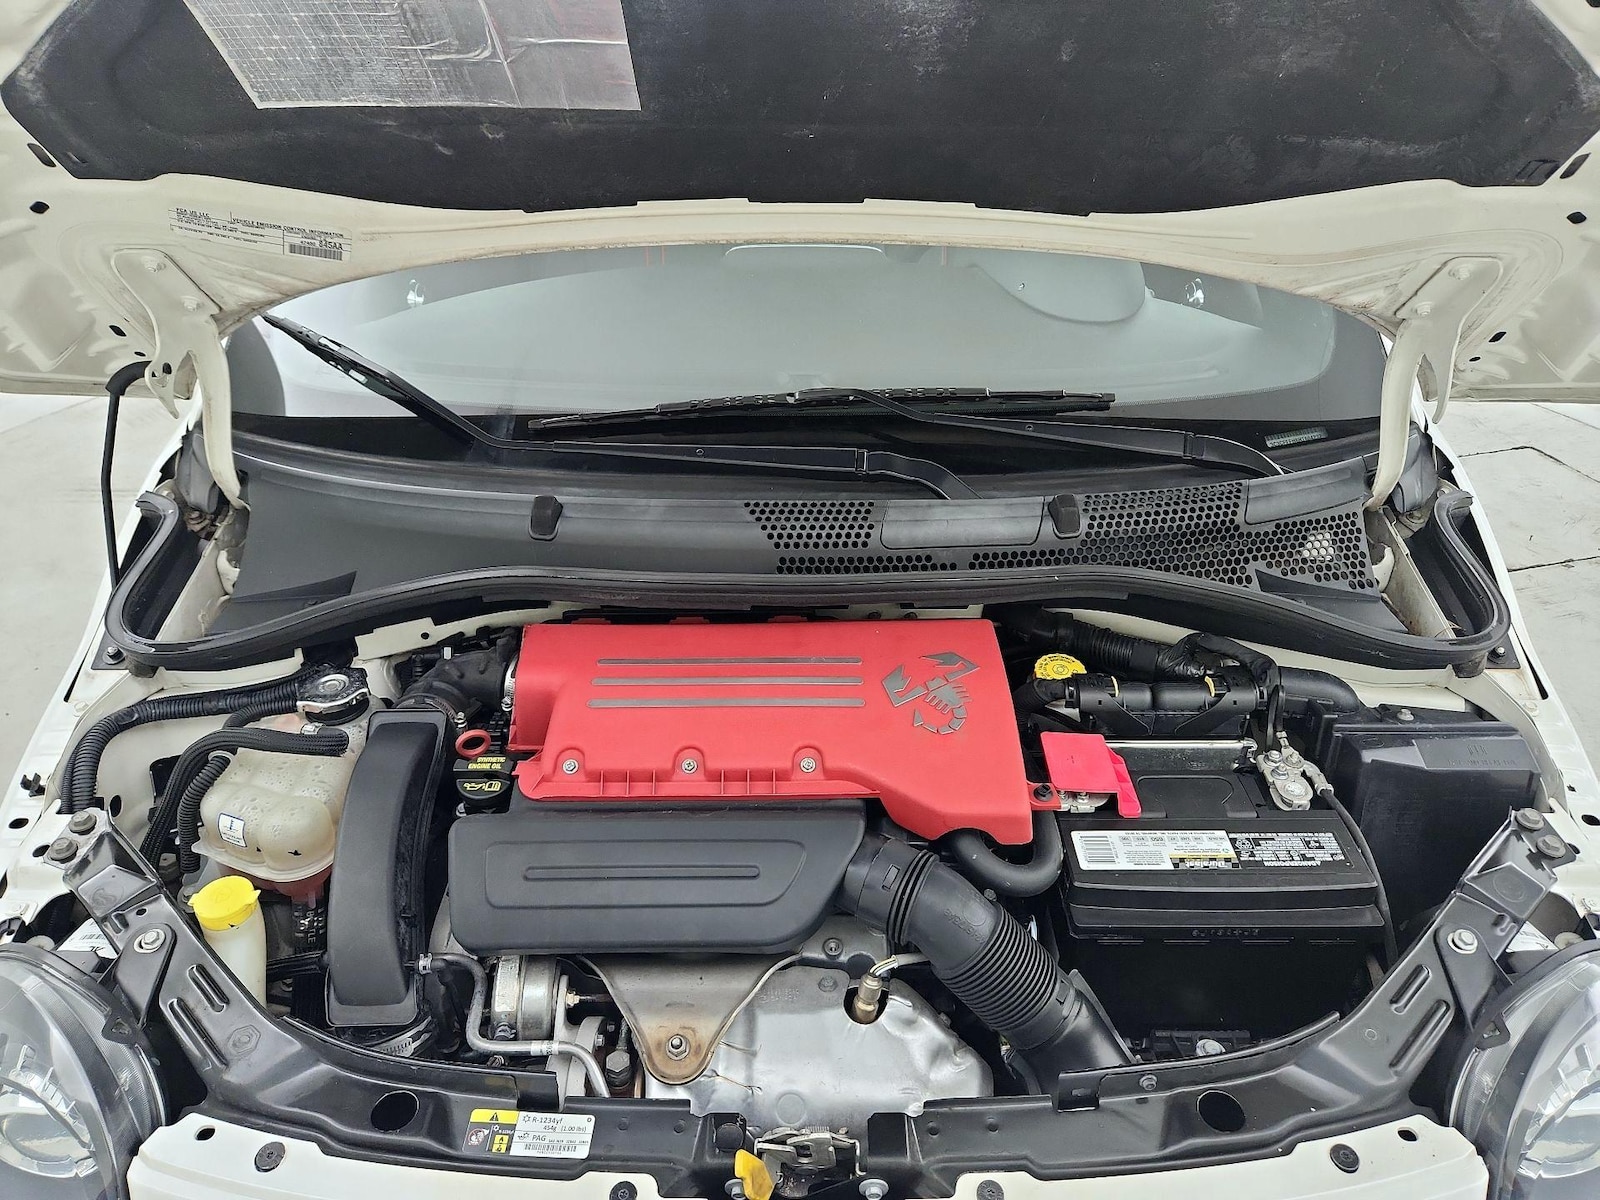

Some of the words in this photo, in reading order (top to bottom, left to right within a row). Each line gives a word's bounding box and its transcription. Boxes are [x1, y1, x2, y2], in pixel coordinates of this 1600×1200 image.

[256, 221, 282, 229] EMISSION
[283, 225, 307, 233] CONTROL
[308, 229, 344, 238] INFORMATION
[1185, 859, 1228, 868] Duralast
[532, 1117, 563, 1126] R-1234yf
[532, 1134, 547, 1142] PAG
